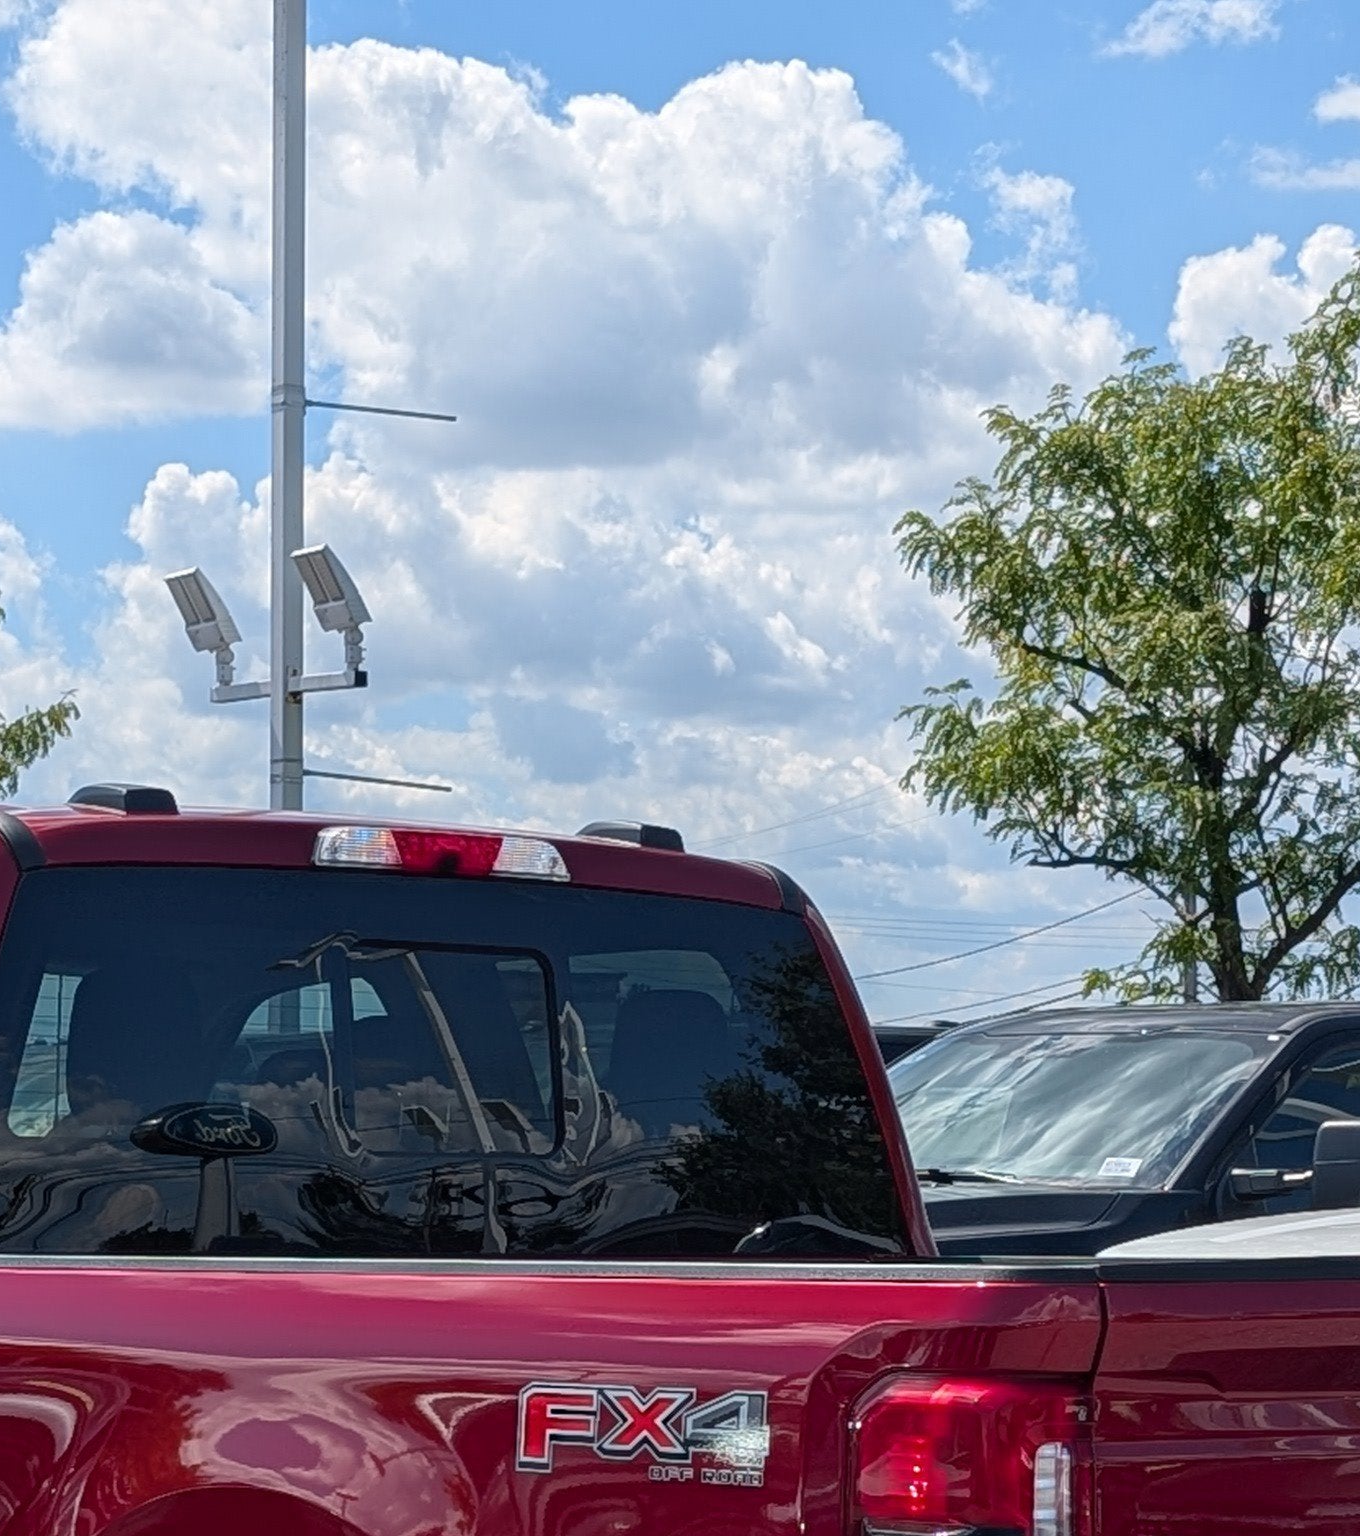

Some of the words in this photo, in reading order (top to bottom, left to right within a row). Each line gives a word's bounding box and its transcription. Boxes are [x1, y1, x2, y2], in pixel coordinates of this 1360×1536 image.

[516, 1381, 770, 1472] FX4
[649, 1466, 694, 1482] OFF
[701, 1467, 764, 1486] ROAD
